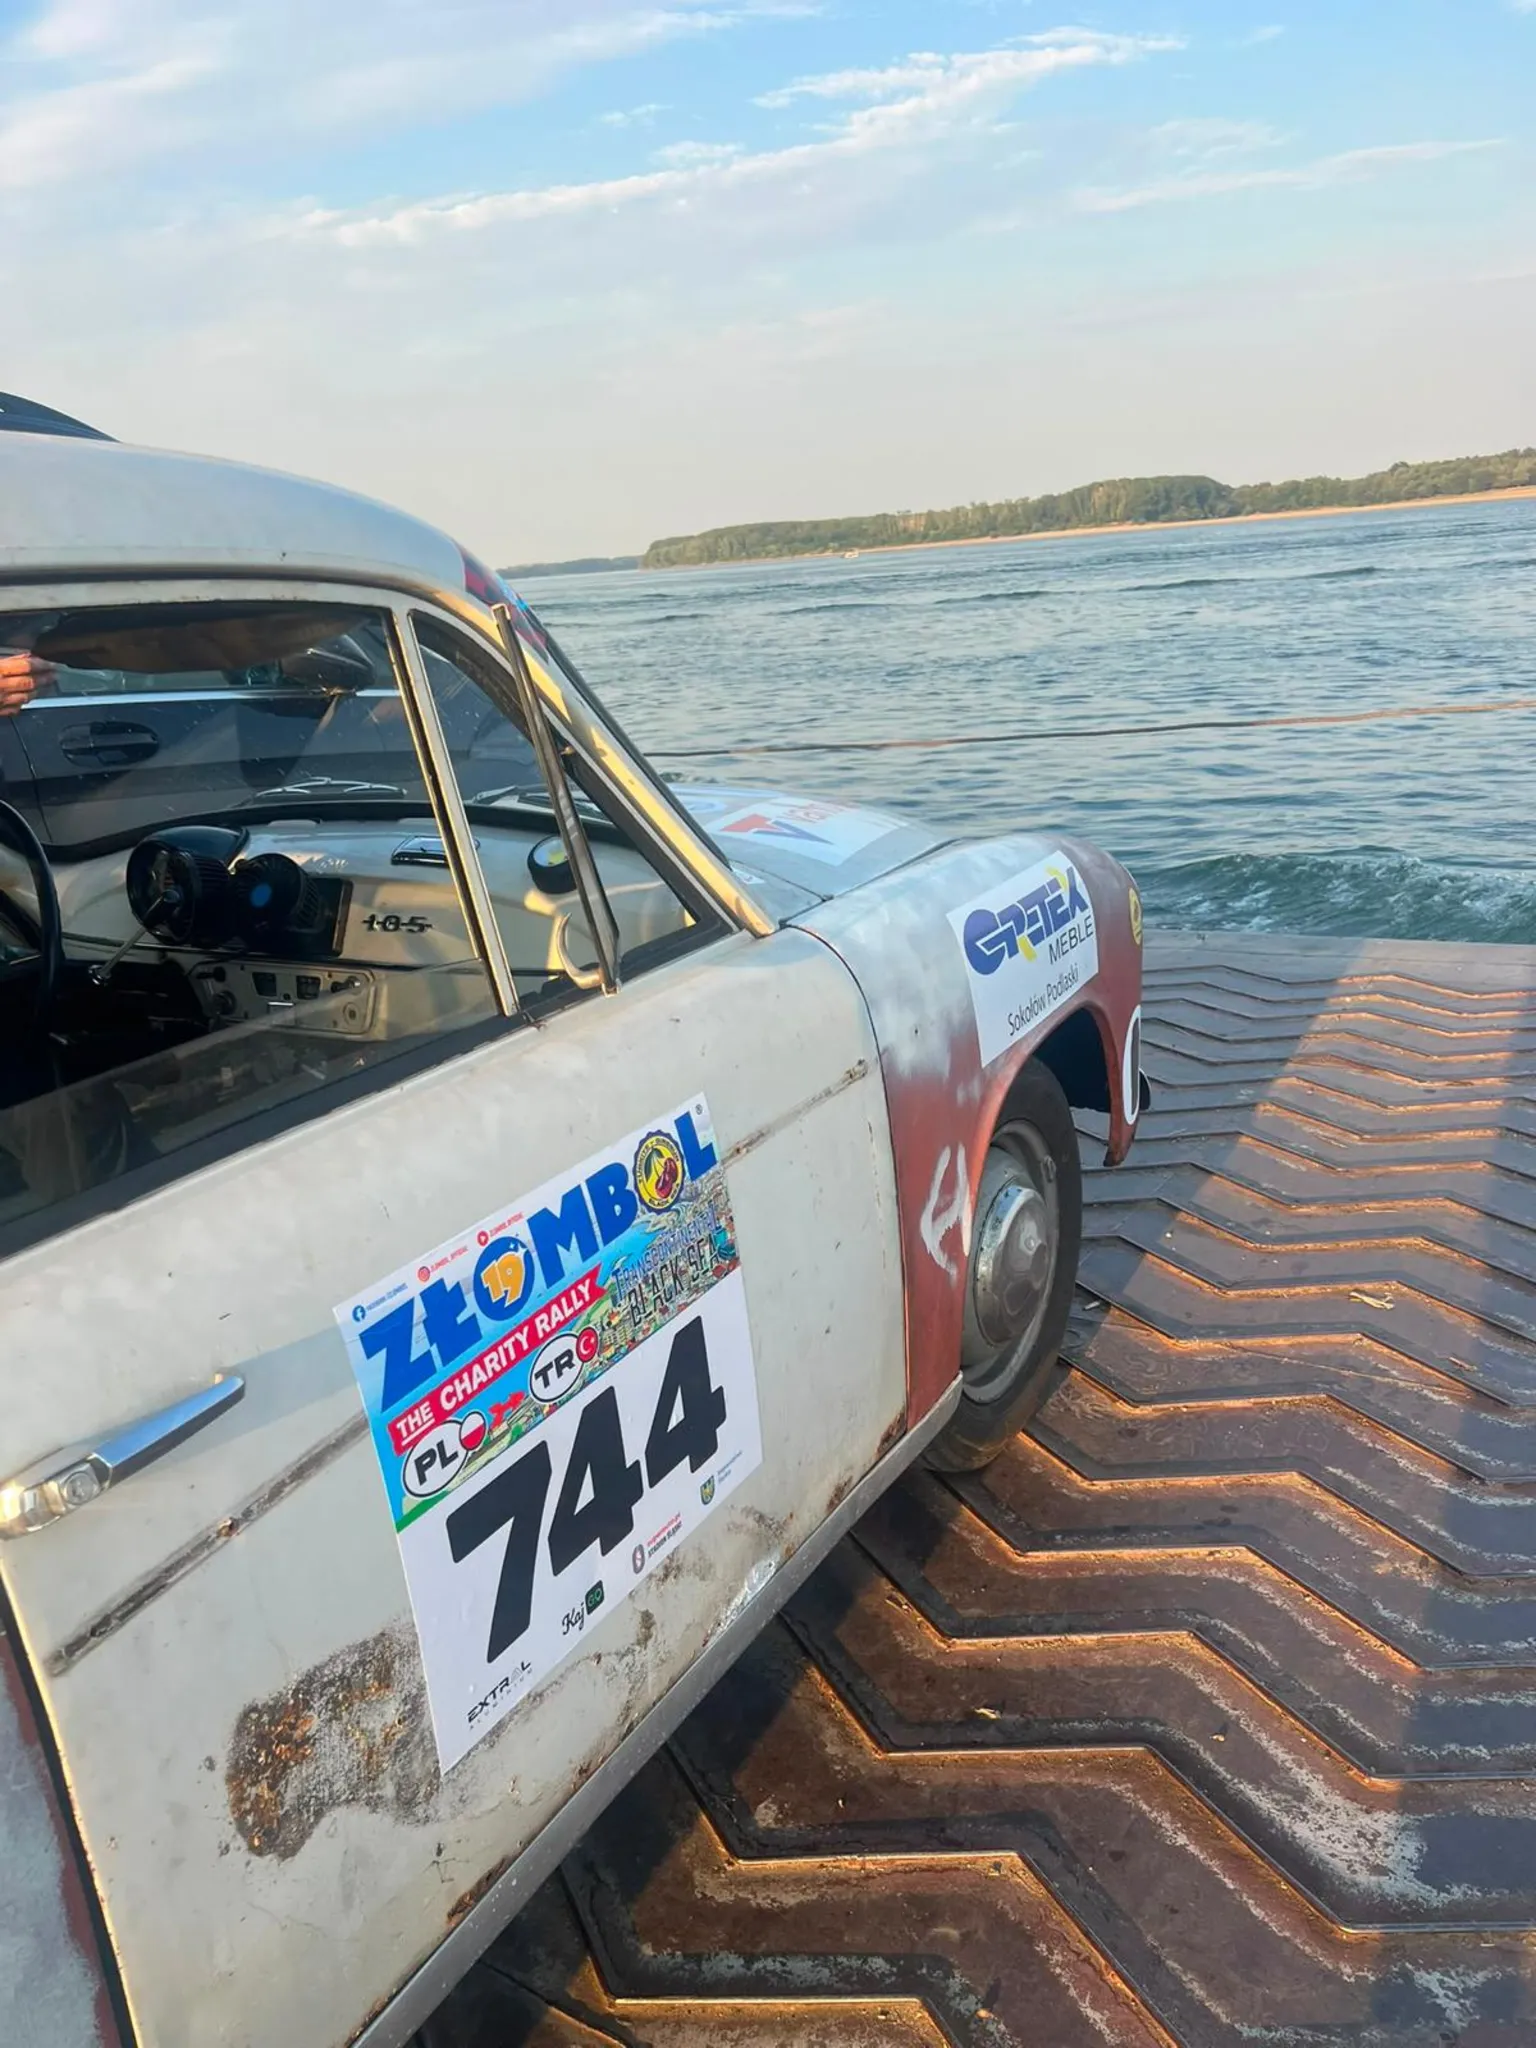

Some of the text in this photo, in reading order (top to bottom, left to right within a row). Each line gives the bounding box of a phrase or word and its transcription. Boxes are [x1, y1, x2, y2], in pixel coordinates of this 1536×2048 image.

[1048, 915, 1094, 965] MEBLE
[1007, 963, 1079, 1037] Sokołów Podlaski
[480, 1250, 525, 1309] 19
[627, 1232, 721, 1327] BLACK SEA
[395, 1279, 593, 1436] THE CHARITY RALLY
[534, 1348, 576, 1389] TR
[413, 1438, 459, 1486] PL
[446, 1315, 727, 1664] 744
[561, 1600, 585, 1636] Kaj
